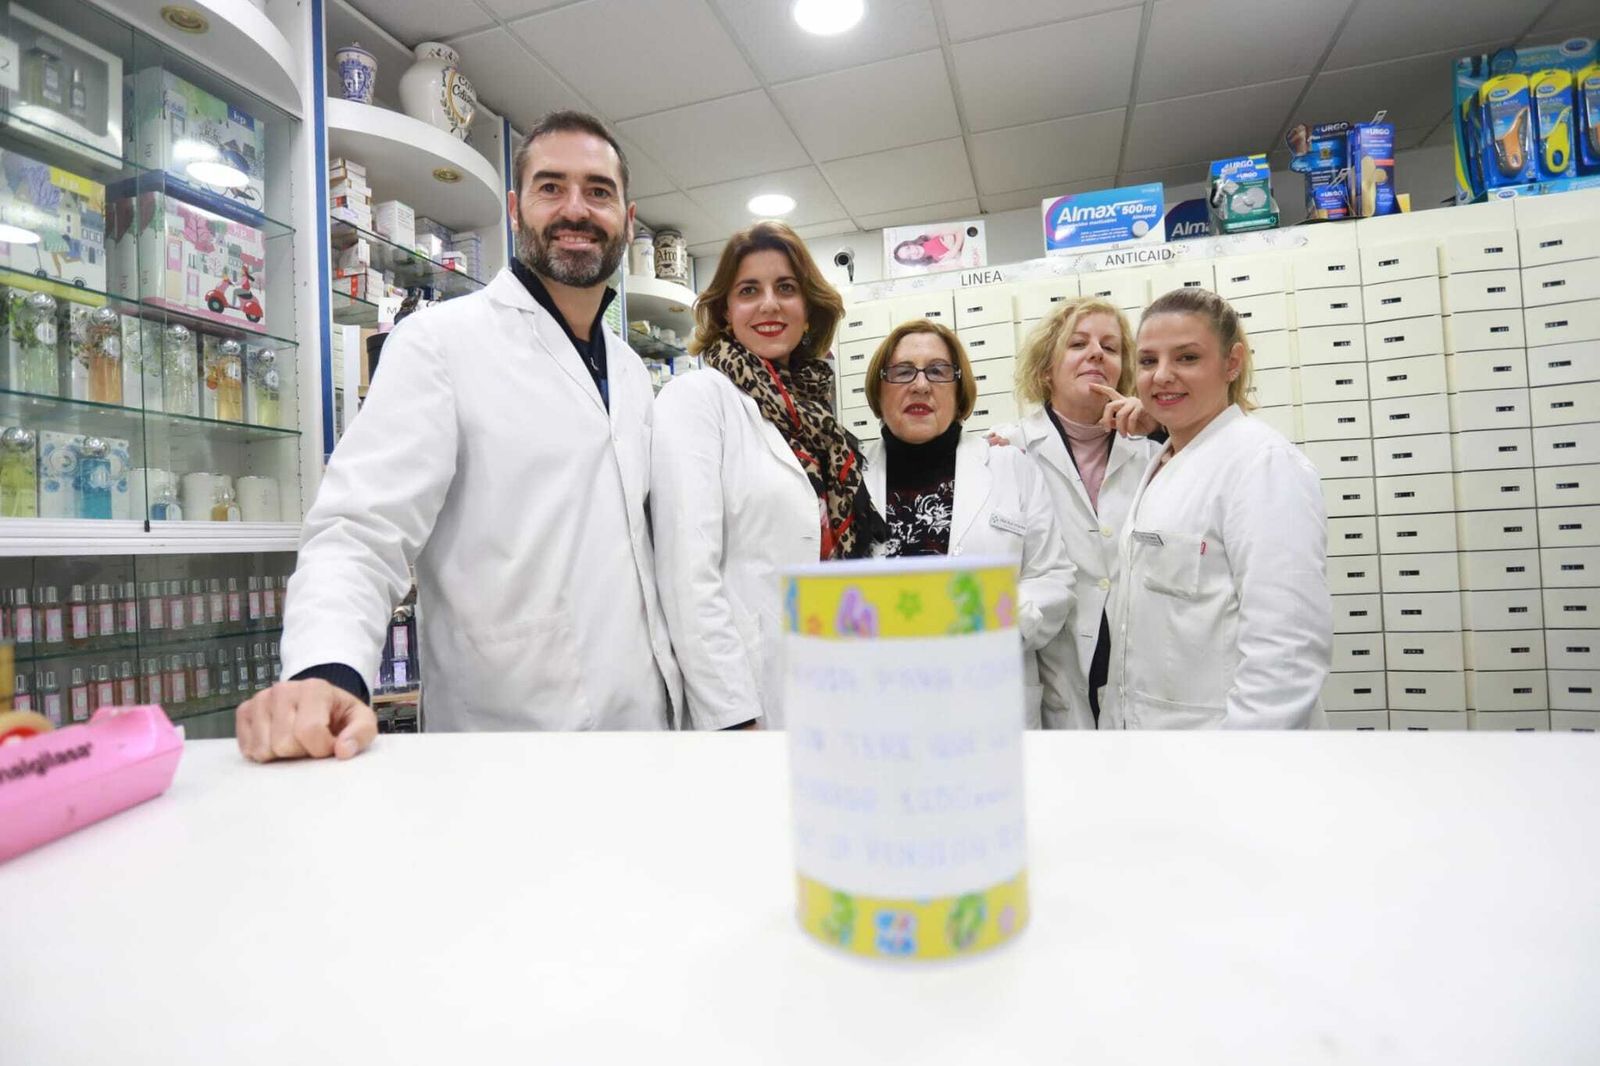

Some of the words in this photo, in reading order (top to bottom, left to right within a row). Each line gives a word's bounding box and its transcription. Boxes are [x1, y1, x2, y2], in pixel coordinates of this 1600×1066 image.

[1321, 122, 1349, 132] URGO
[1229, 159, 1254, 169] URGO
[1057, 203, 1117, 224] Almax
[961, 270, 1003, 287] LINEA
